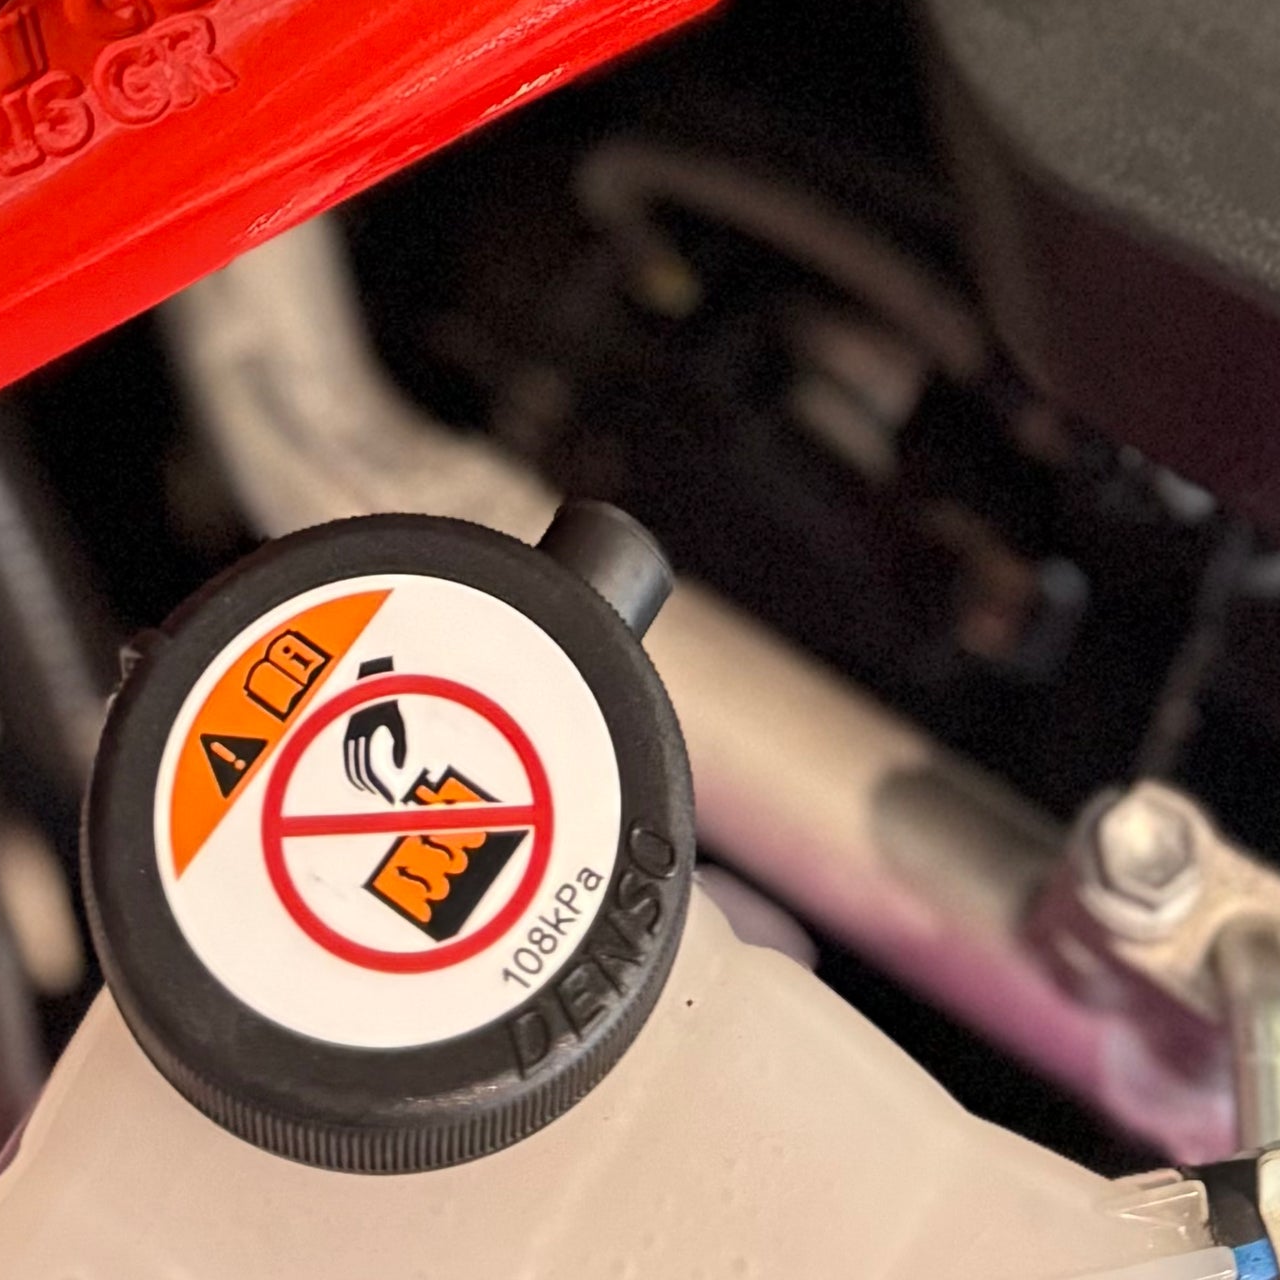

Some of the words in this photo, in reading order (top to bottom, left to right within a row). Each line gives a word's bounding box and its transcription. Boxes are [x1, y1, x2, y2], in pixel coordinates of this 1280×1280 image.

[93, 13, 238, 125] GR
[502, 867, 605, 989] 108kPa
[507, 816, 676, 1082] DENSO
